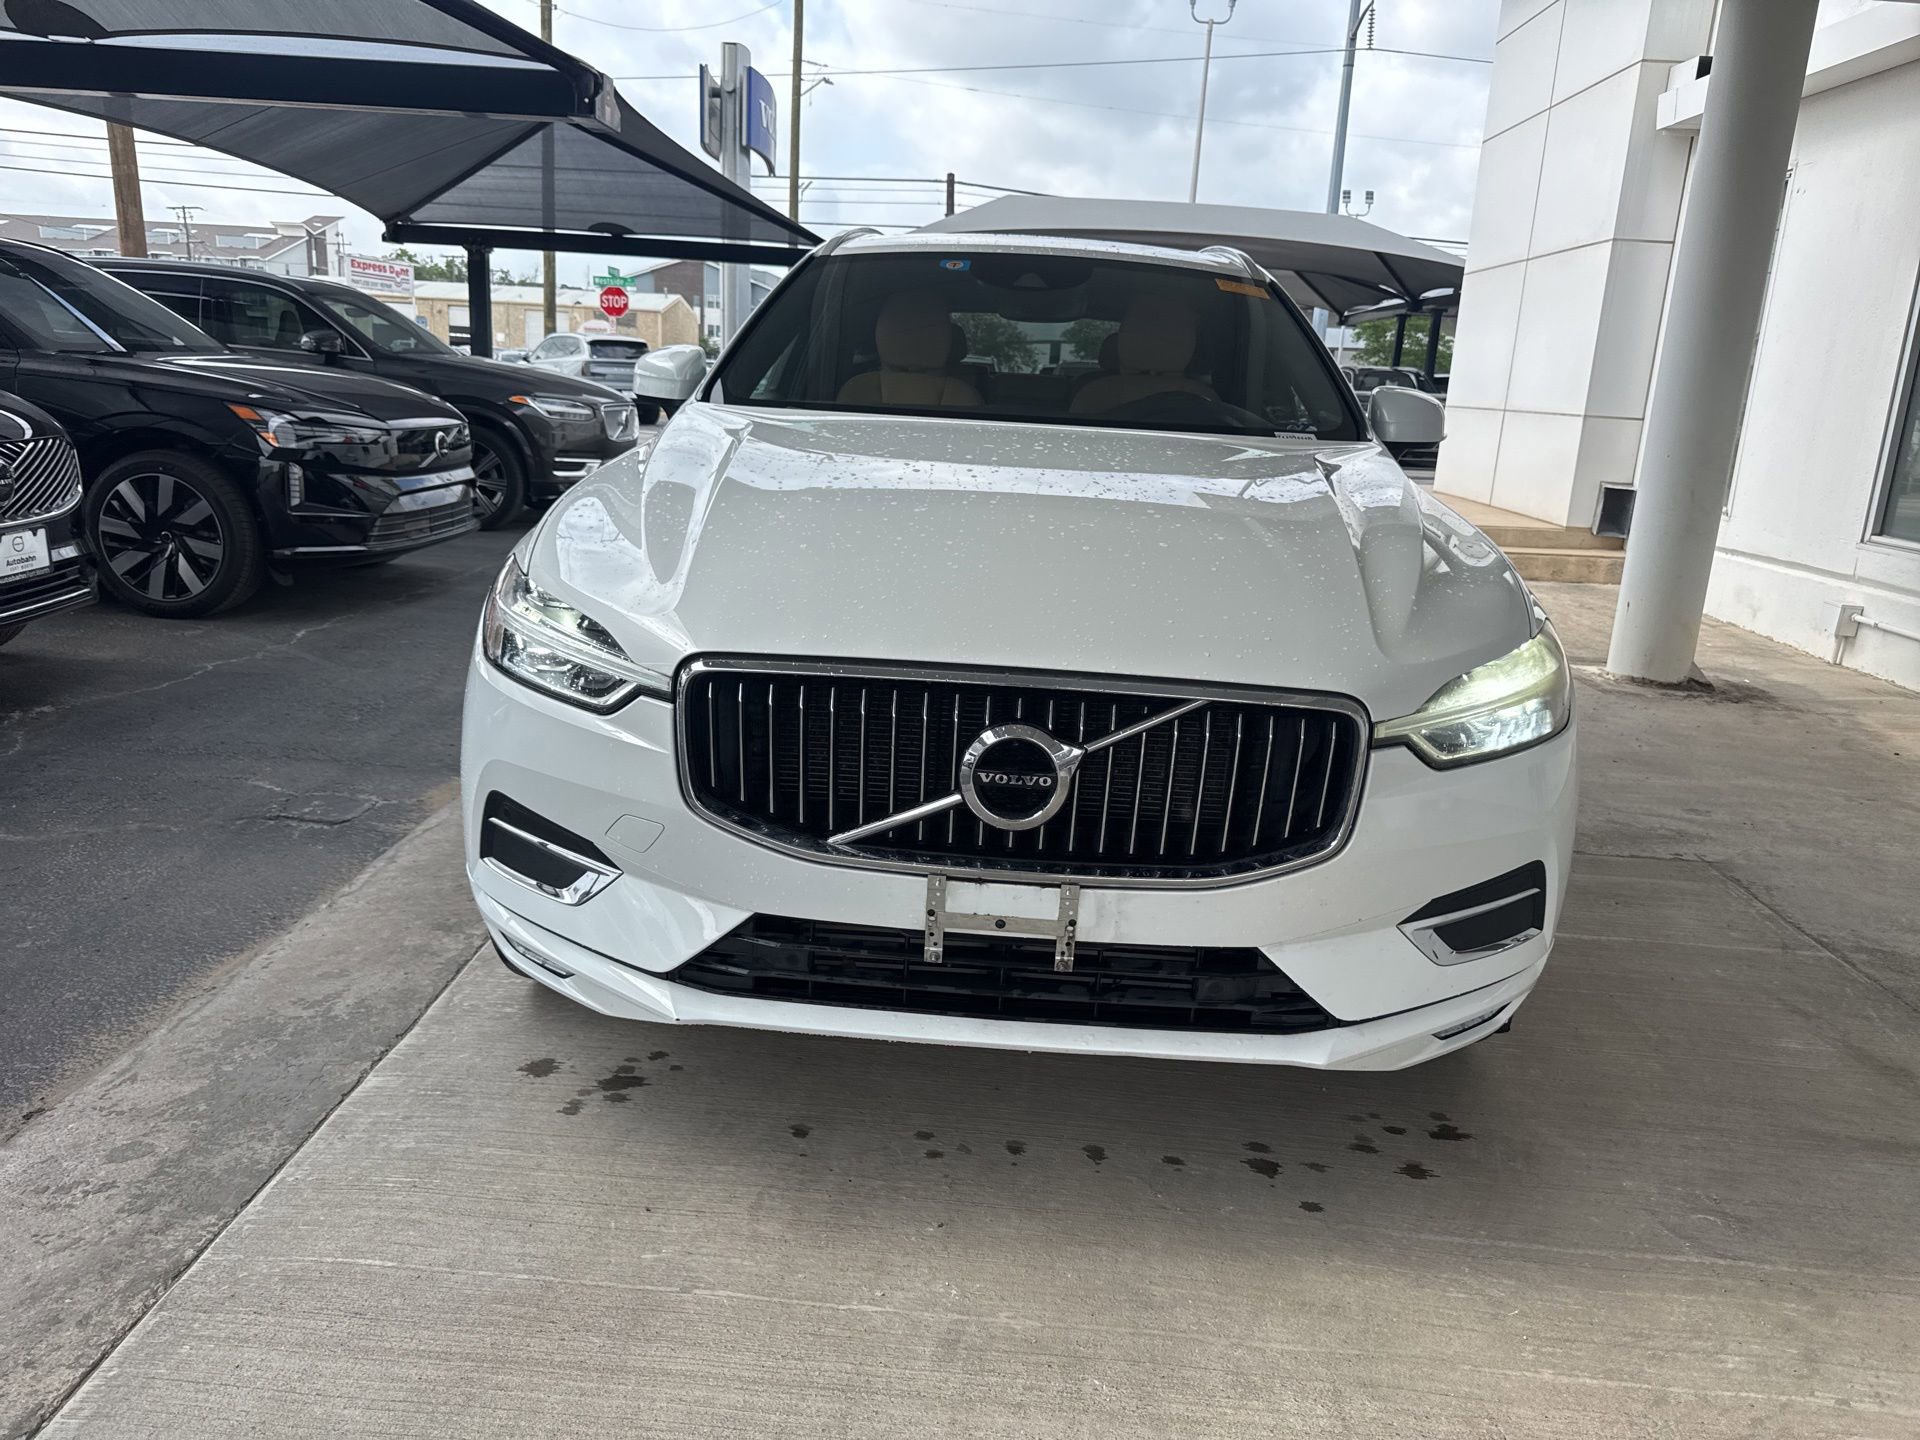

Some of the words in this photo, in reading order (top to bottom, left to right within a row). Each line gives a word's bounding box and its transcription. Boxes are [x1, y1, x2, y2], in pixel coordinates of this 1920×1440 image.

[351, 259, 388, 273] Express
[389, 265, 409, 278] Dent
[601, 295, 628, 308] STOP
[6, 555, 37, 568] Autobahn
[978, 772, 1052, 787] VOLVO
